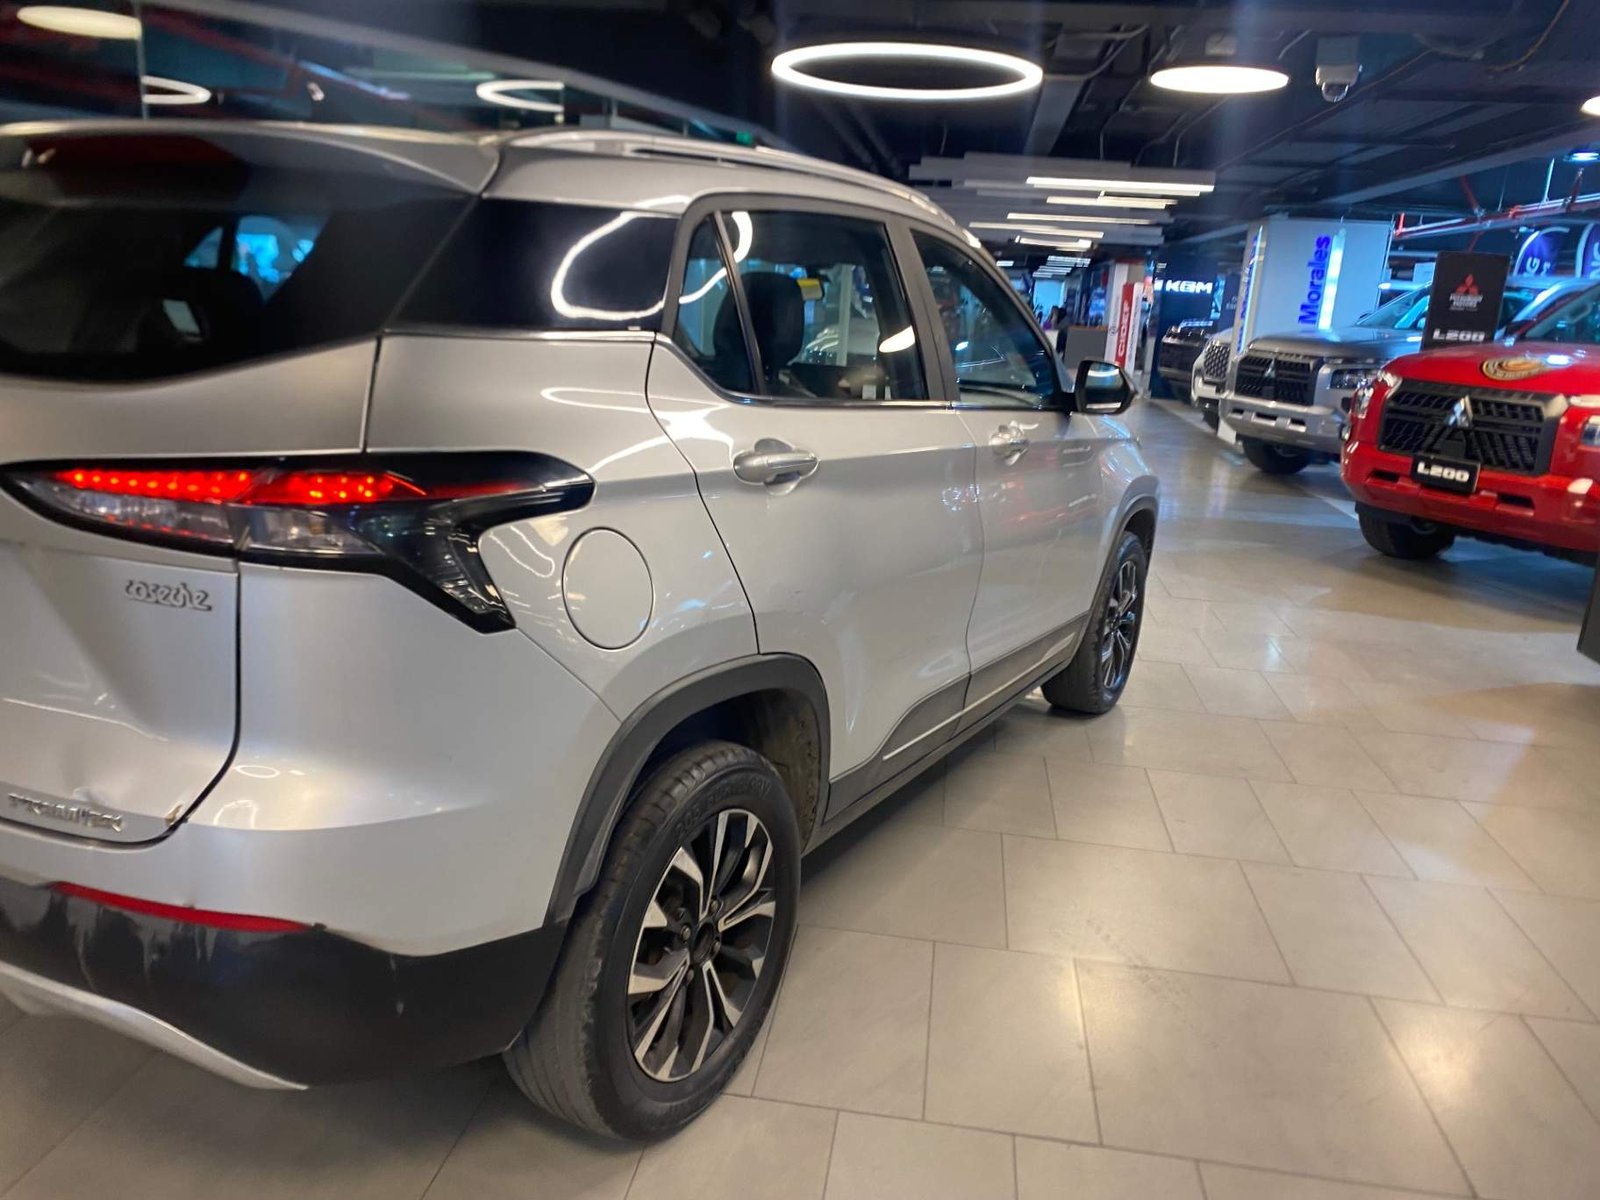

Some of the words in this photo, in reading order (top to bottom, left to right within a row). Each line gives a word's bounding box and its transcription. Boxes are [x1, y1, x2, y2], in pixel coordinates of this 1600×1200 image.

[1165, 279, 1213, 294] KGM
[1298, 235, 1332, 325] Morales
[1117, 300, 1131, 358] CIDEF
[1432, 328, 1486, 342] L200
[1416, 461, 1470, 483] L200
